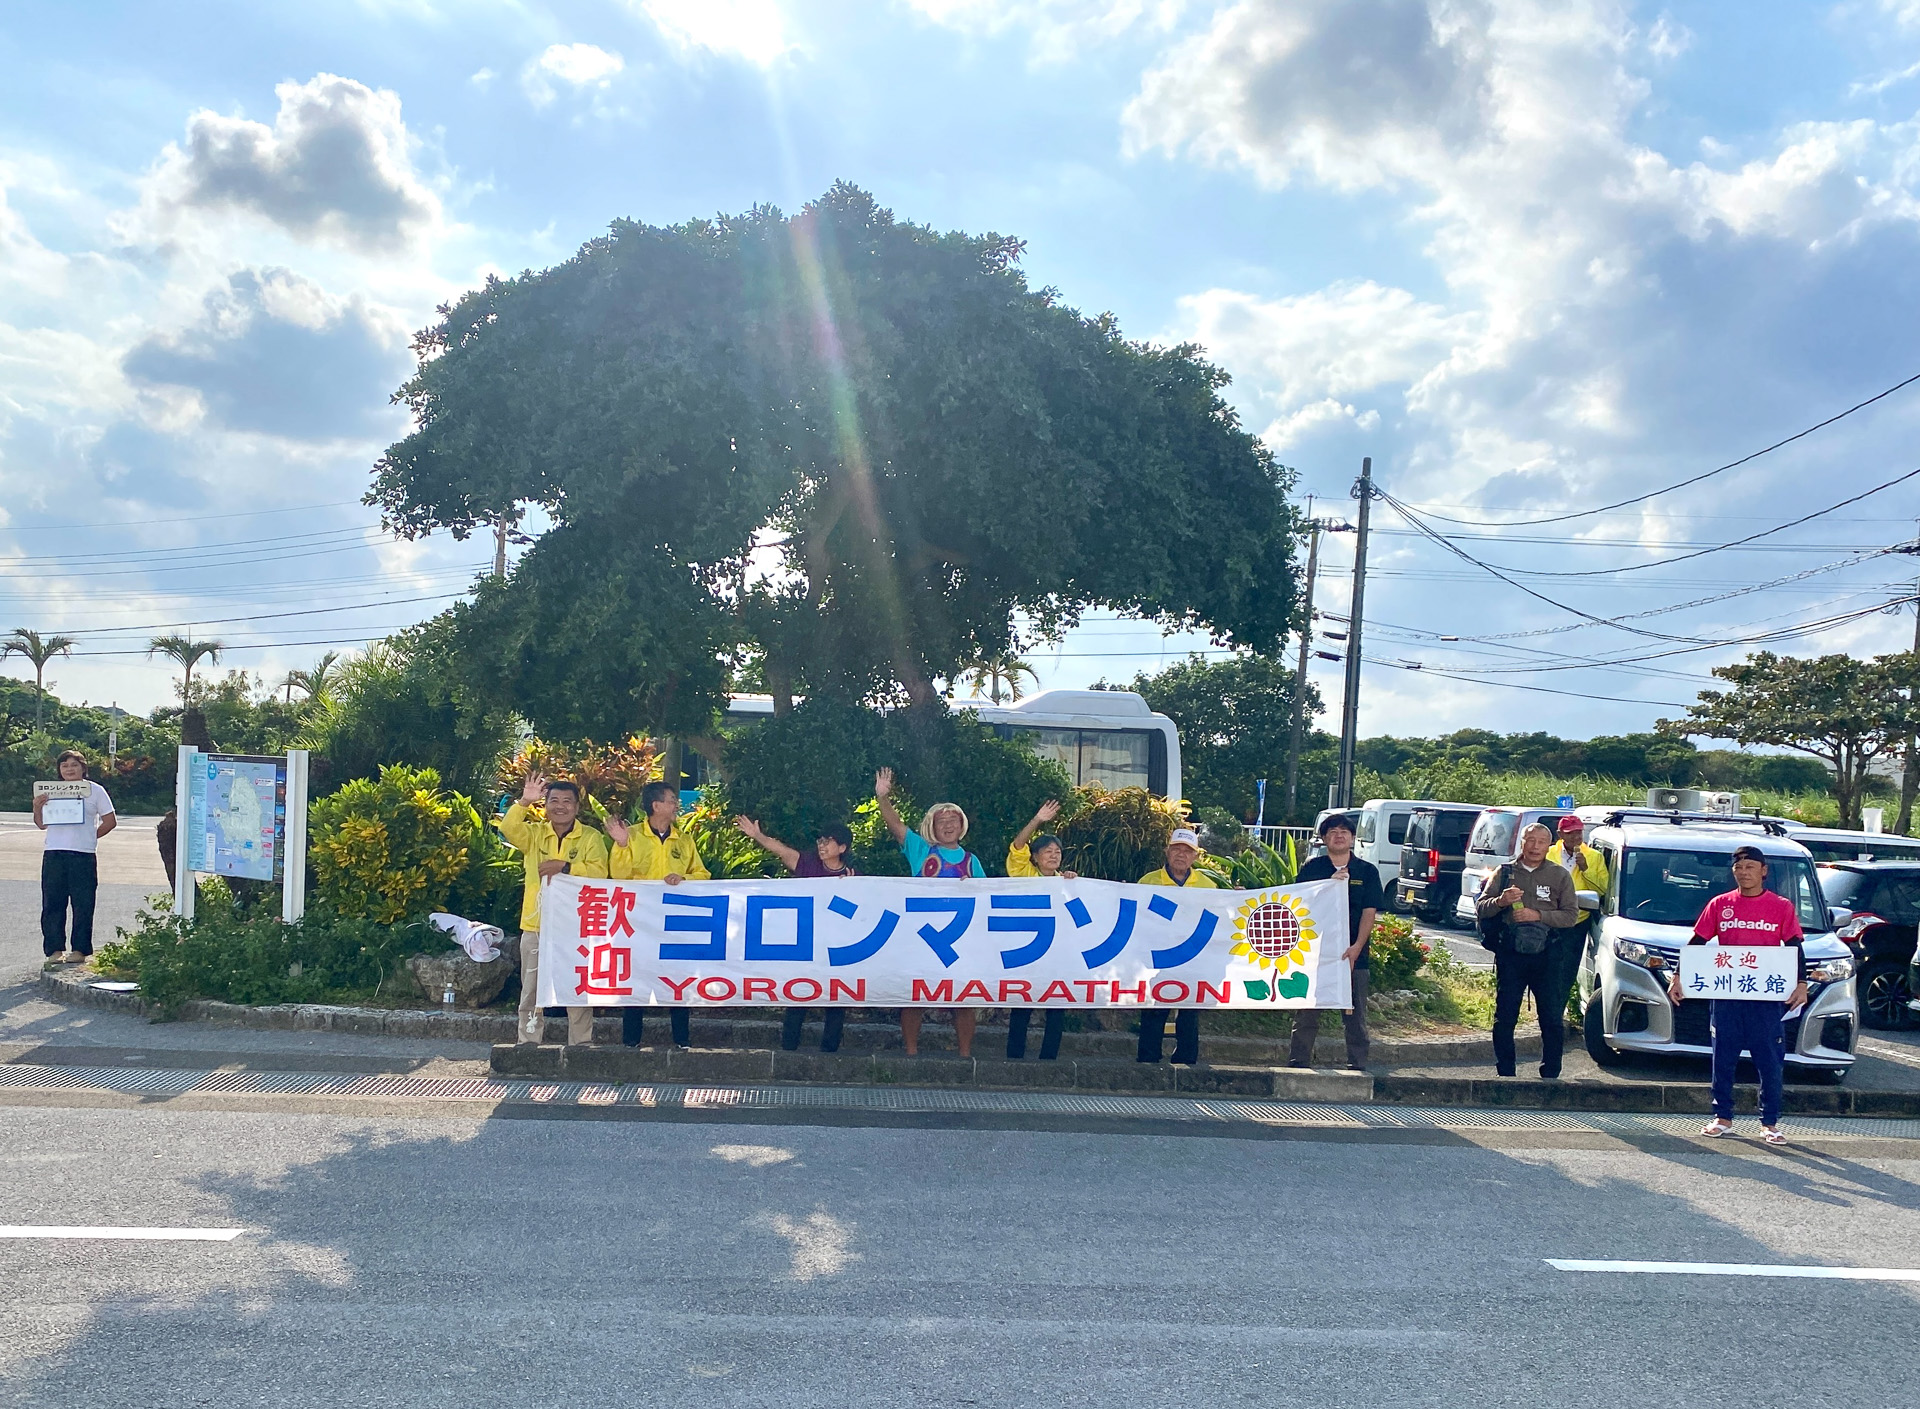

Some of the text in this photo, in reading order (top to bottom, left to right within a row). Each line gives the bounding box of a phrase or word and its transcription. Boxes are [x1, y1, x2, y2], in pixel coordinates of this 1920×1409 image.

[659, 893, 1219, 970] ヨロンマラソン
[1719, 918, 1778, 932] goleador
[575, 885, 636, 995] 歓迎
[1714, 951, 1759, 969] 歓迎
[659, 976, 1231, 1003] YORON MARATHON
[1688, 973, 1787, 994] 与州旅館
